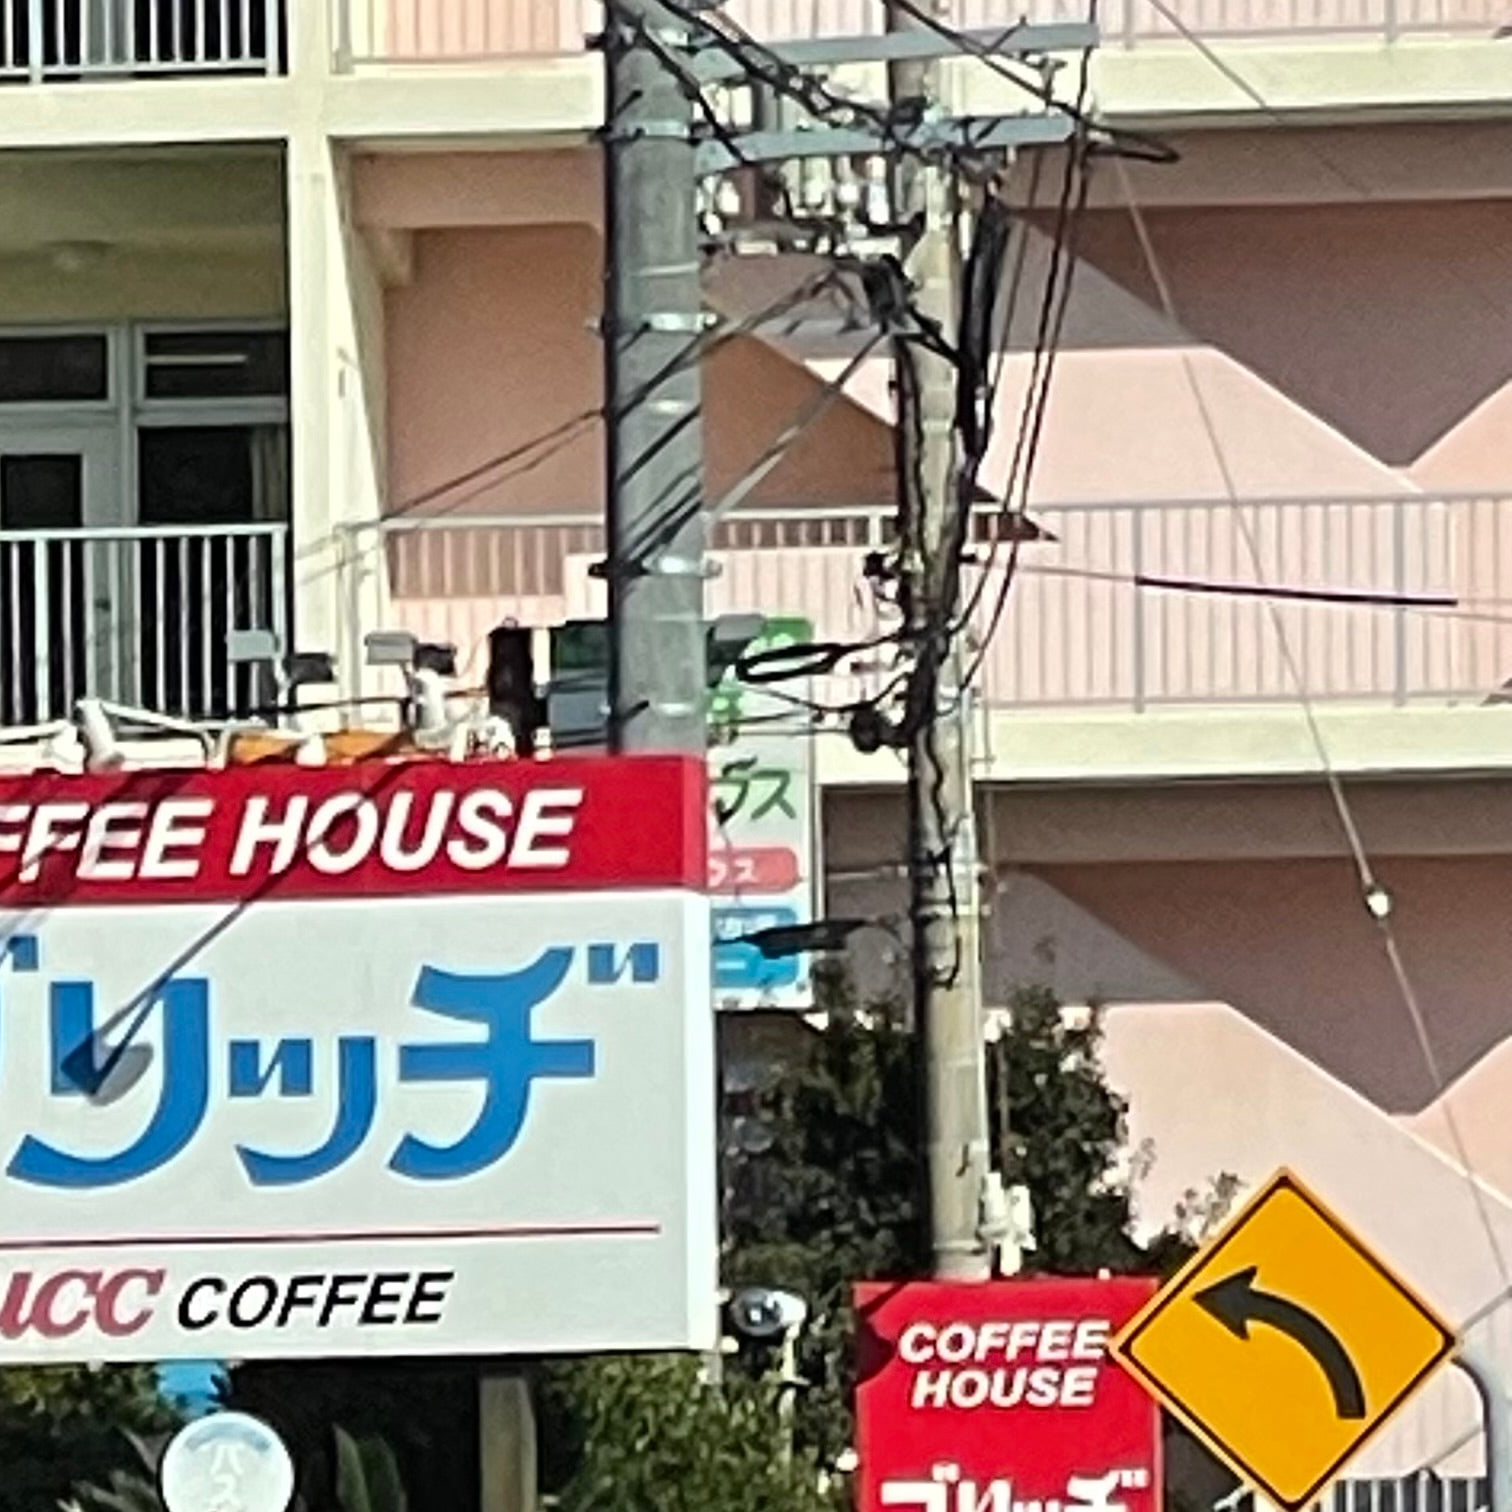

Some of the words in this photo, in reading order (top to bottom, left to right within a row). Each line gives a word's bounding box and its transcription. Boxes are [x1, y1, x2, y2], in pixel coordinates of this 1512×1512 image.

[229, 787, 584, 876] HOUSE
[177, 1270, 455, 1331] COFFEE
[898, 1319, 1111, 1364] COFFEE
[910, 1366, 1099, 1409] HOUSE
